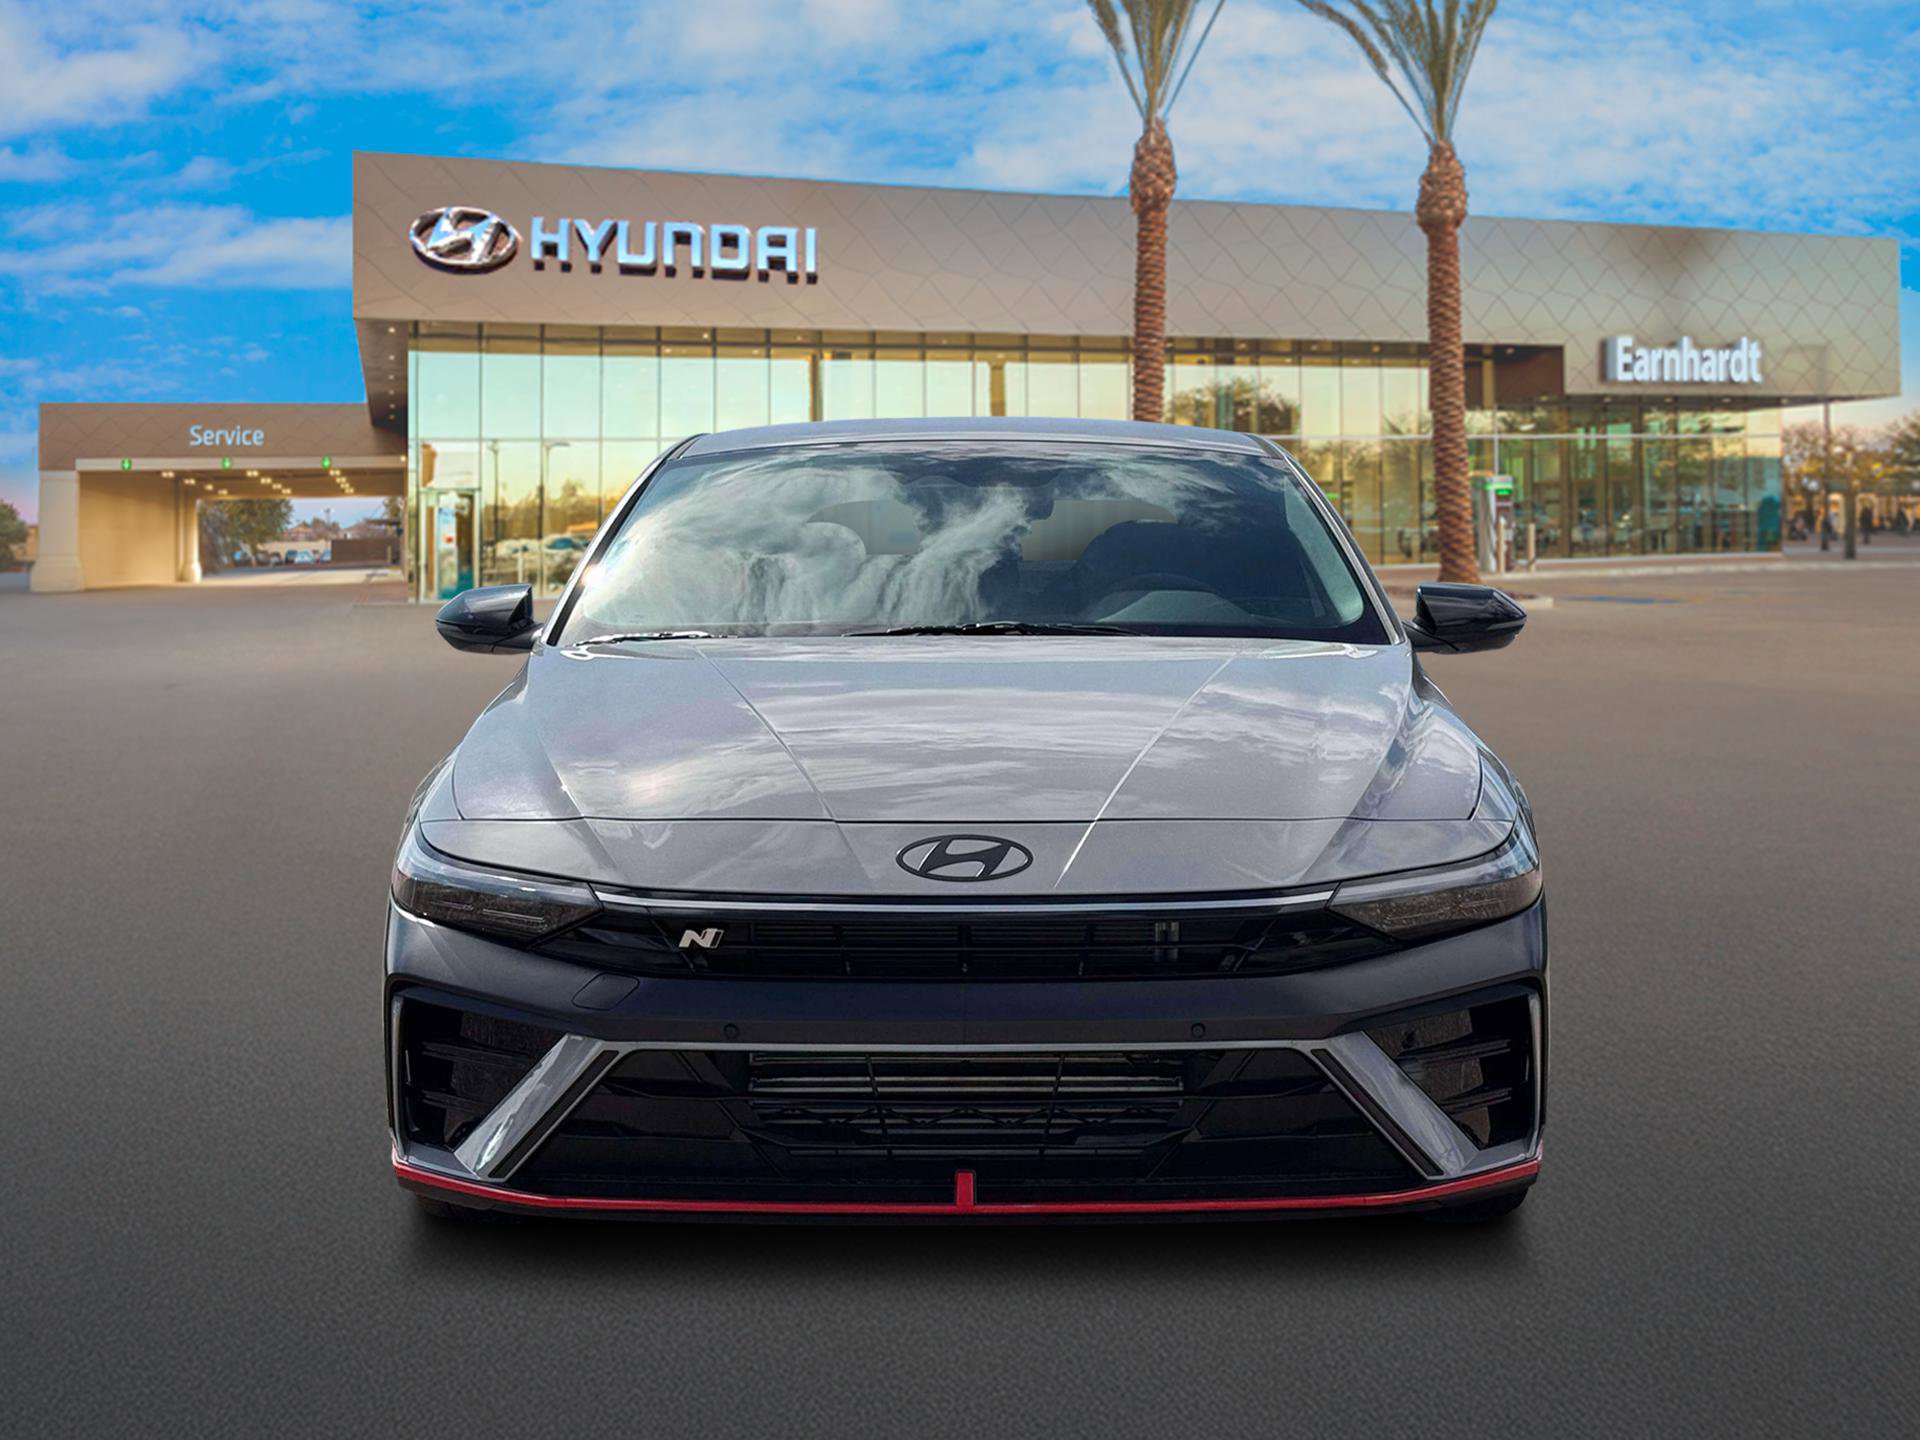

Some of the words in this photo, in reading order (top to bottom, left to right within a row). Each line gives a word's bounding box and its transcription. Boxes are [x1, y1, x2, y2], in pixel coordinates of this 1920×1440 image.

[530, 216, 818, 276] HYUNDAI
[1613, 335, 1763, 382] Earnhardt
[189, 424, 265, 447] Service
